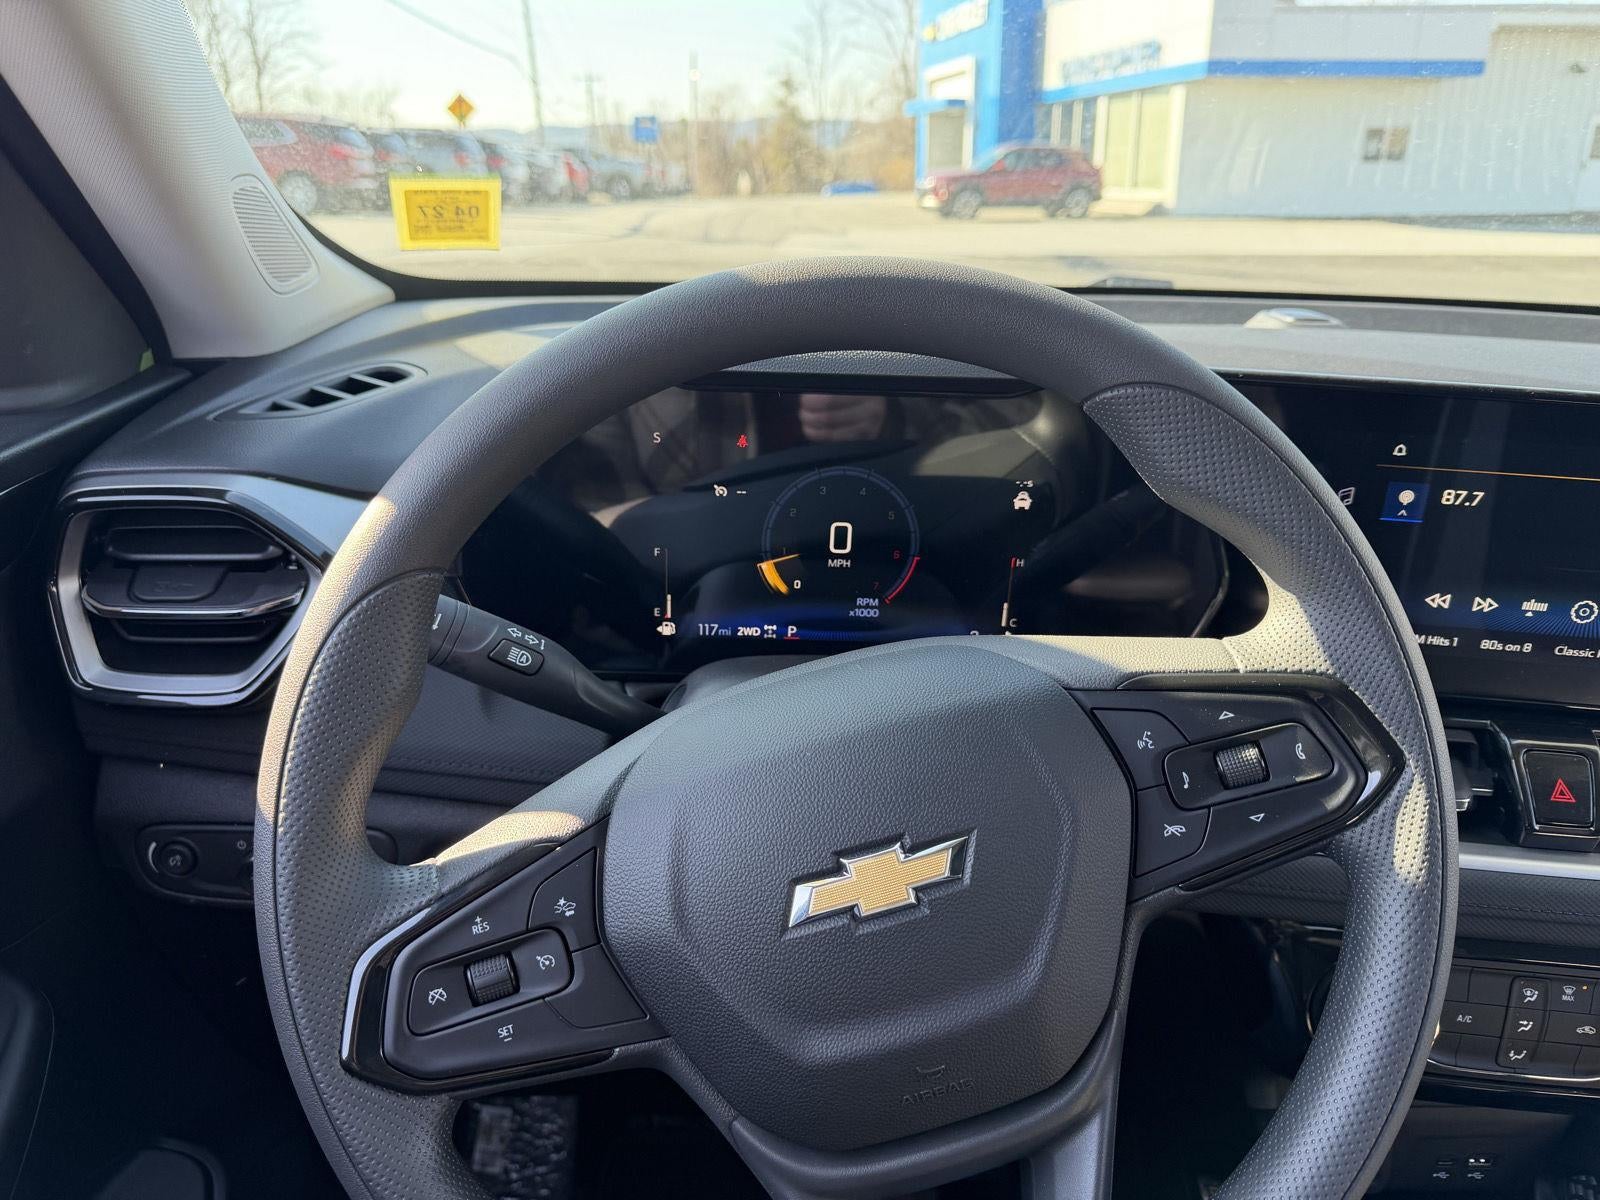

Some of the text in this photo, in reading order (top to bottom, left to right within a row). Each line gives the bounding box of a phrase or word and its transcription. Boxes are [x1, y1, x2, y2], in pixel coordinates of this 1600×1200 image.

[653, 432, 661, 444] S
[819, 486, 827, 495] 3
[860, 487, 867, 496] 4
[1441, 489, 1485, 507] 87.7
[790, 508, 797, 517] 2
[888, 511, 895, 520] 5
[829, 521, 853, 554] 0
[654, 547, 661, 557] F
[893, 550, 900, 559] 6
[827, 559, 851, 568] MPH
[1016, 558, 1024, 568] H
[793, 579, 802, 589] 0
[856, 597, 879, 607] RPM
[654, 607, 661, 617] E
[848, 608, 879, 618] x1000
[1009, 618, 1017, 628] C
[737, 626, 761, 637] 2WD
[787, 625, 798, 637] P
[1426, 635, 1450, 646] Hits
[1452, 637, 1459, 647] 1
[1480, 639, 1533, 653] 80s on 8
[1554, 645, 1595, 658] Classic
[471, 921, 490, 935] RES
[1562, 994, 1575, 1002] MAX
[1456, 1014, 1473, 1023] A/C
[497, 1024, 514, 1038] SET
